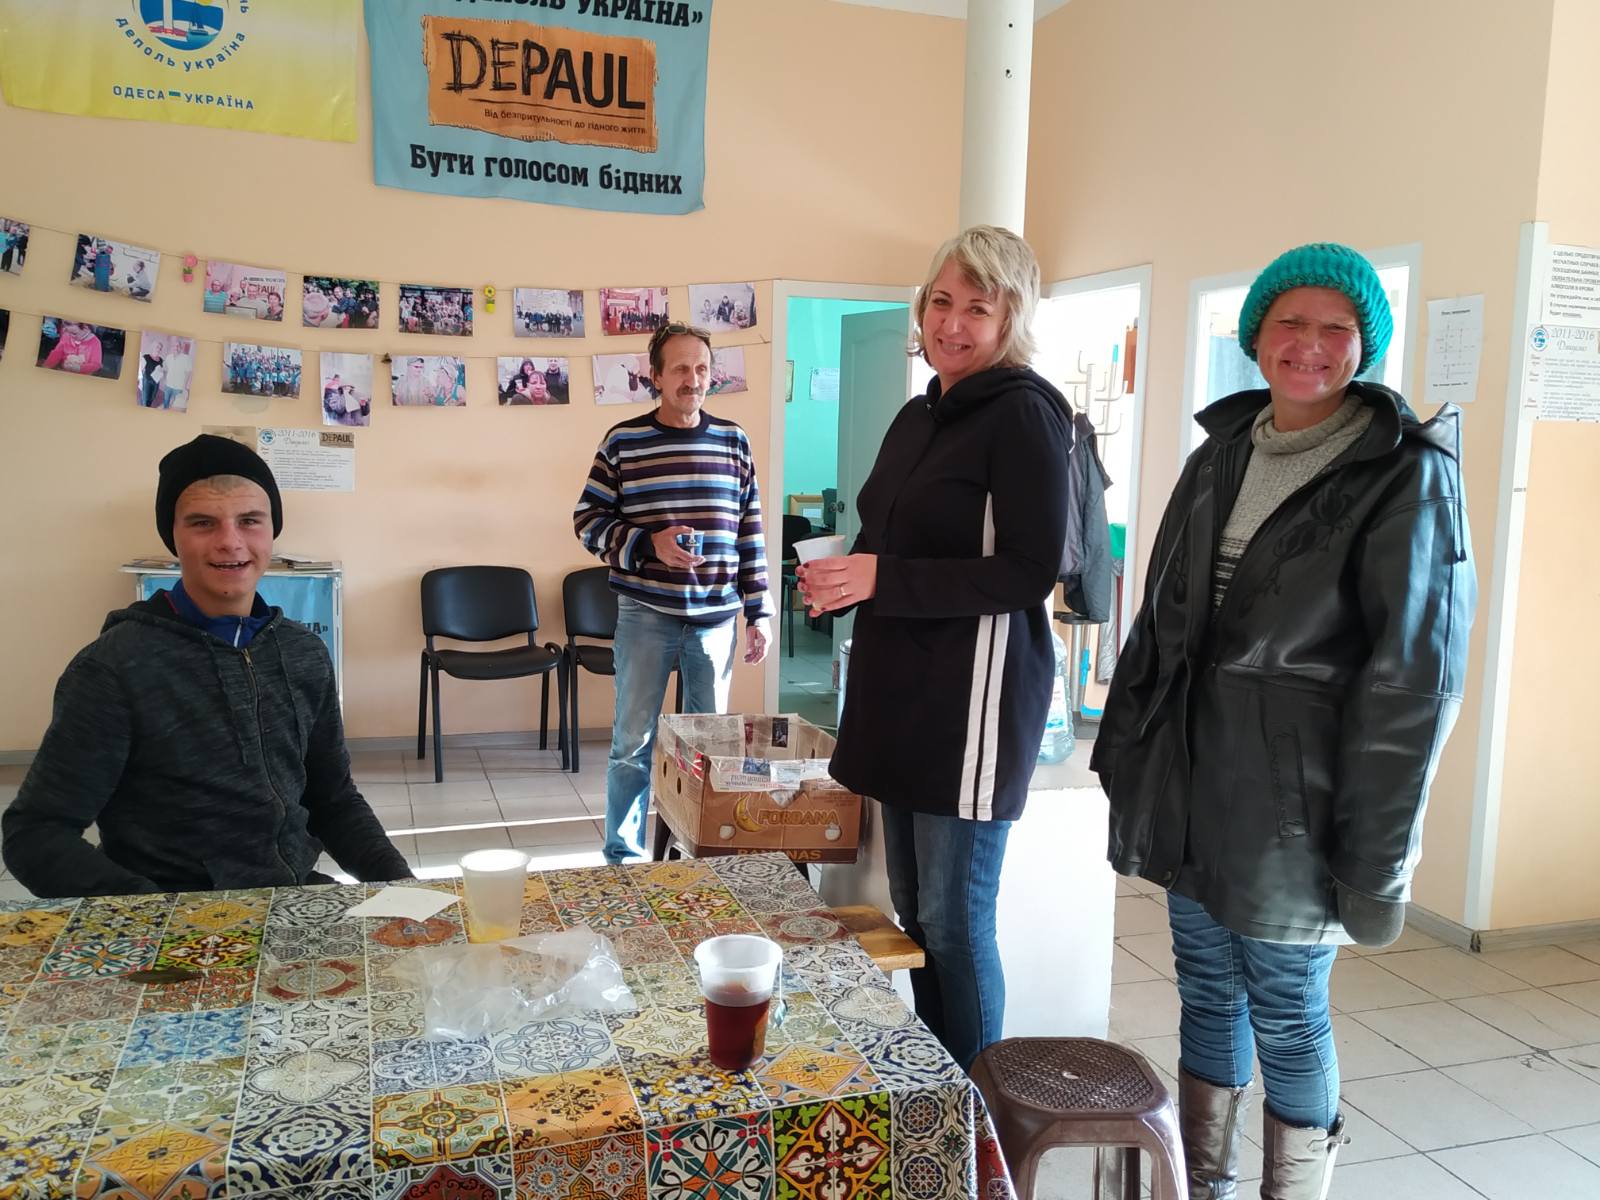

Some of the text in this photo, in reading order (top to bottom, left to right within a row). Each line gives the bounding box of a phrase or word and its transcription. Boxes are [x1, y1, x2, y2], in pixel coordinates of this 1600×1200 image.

[440, 30, 646, 110] DEPAUL
[484, 108, 499, 120] Від
[500, 109, 573, 128] безпритульності
[574, 121, 586, 129] до
[587, 122, 620, 133] гідного
[409, 143, 683, 195] Бути голосом бідних
[320, 431, 353, 443] DEPAUL
